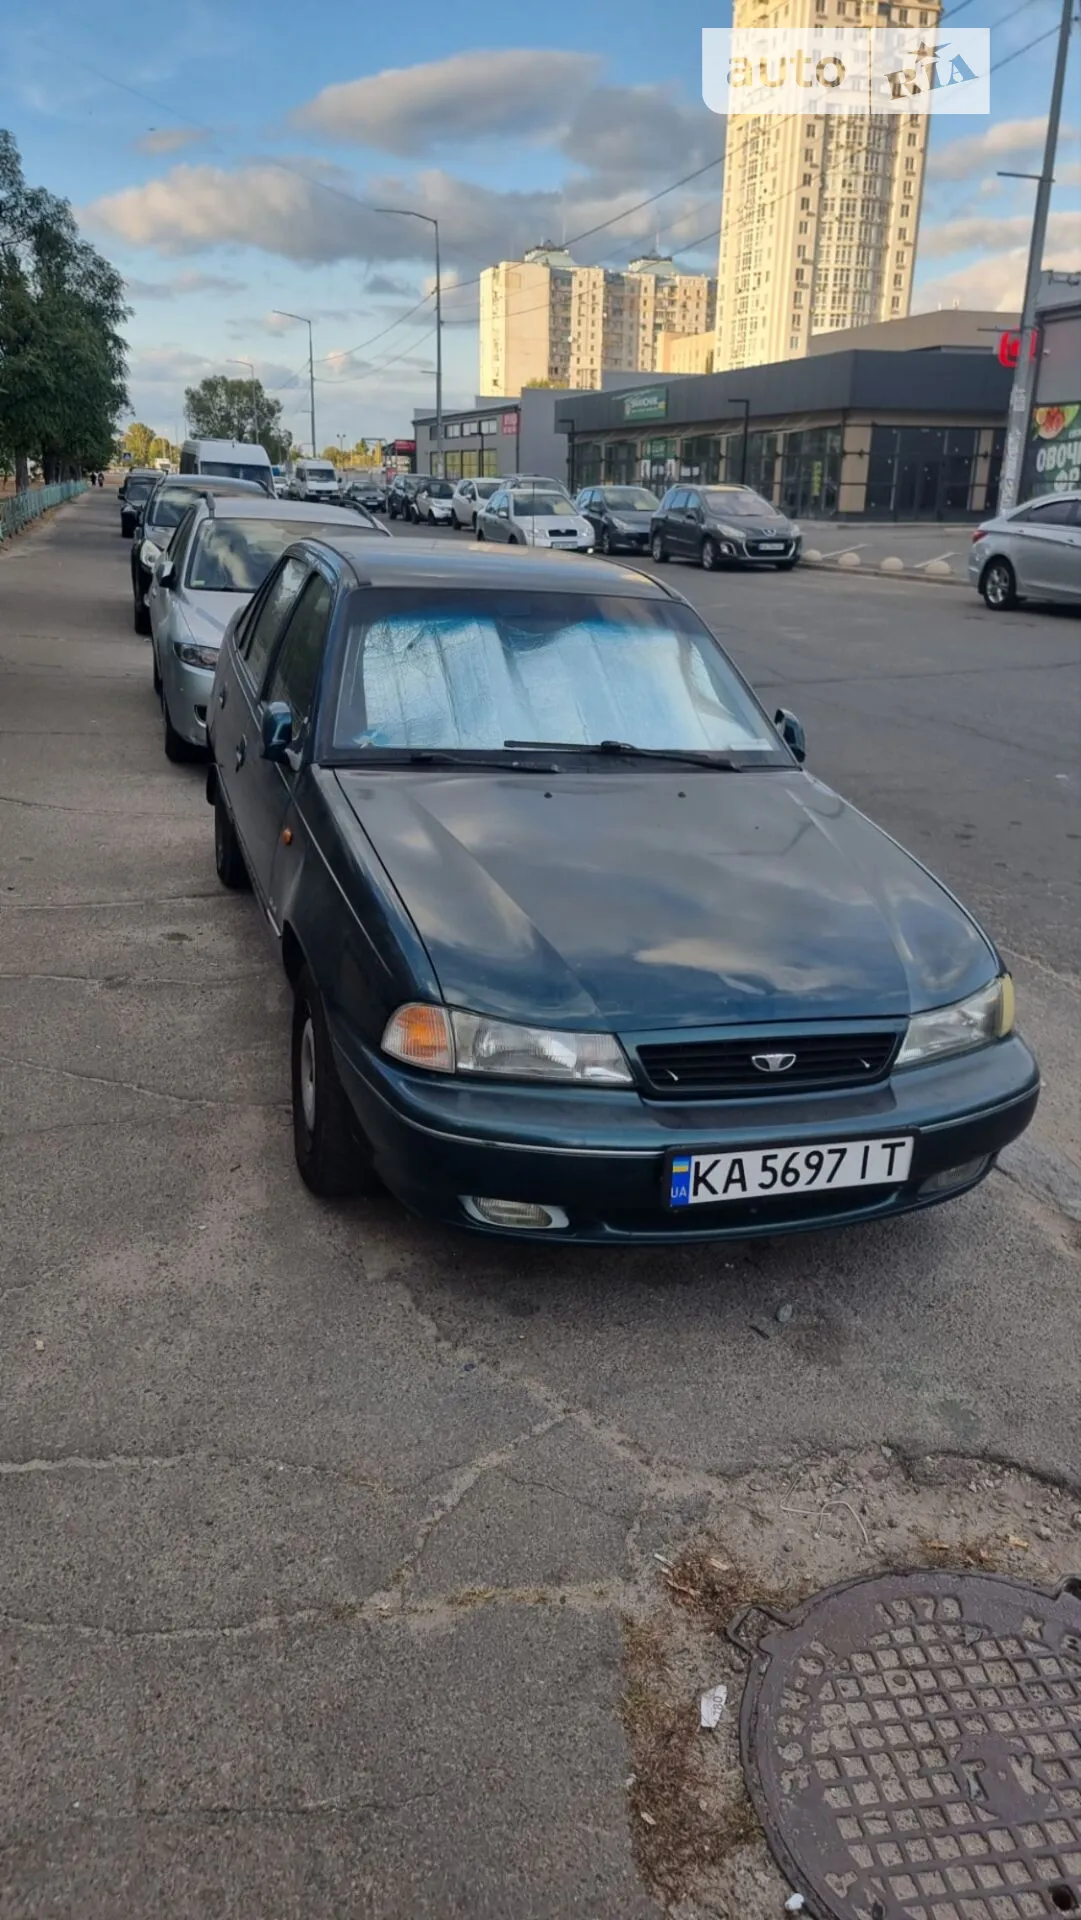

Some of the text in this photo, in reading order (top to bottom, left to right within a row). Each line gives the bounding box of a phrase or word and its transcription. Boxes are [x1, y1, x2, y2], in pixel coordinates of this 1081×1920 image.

[692, 1158, 748, 1197] KA
[758, 1148, 848, 1190] 5697
[670, 1186, 688, 1199] UA
